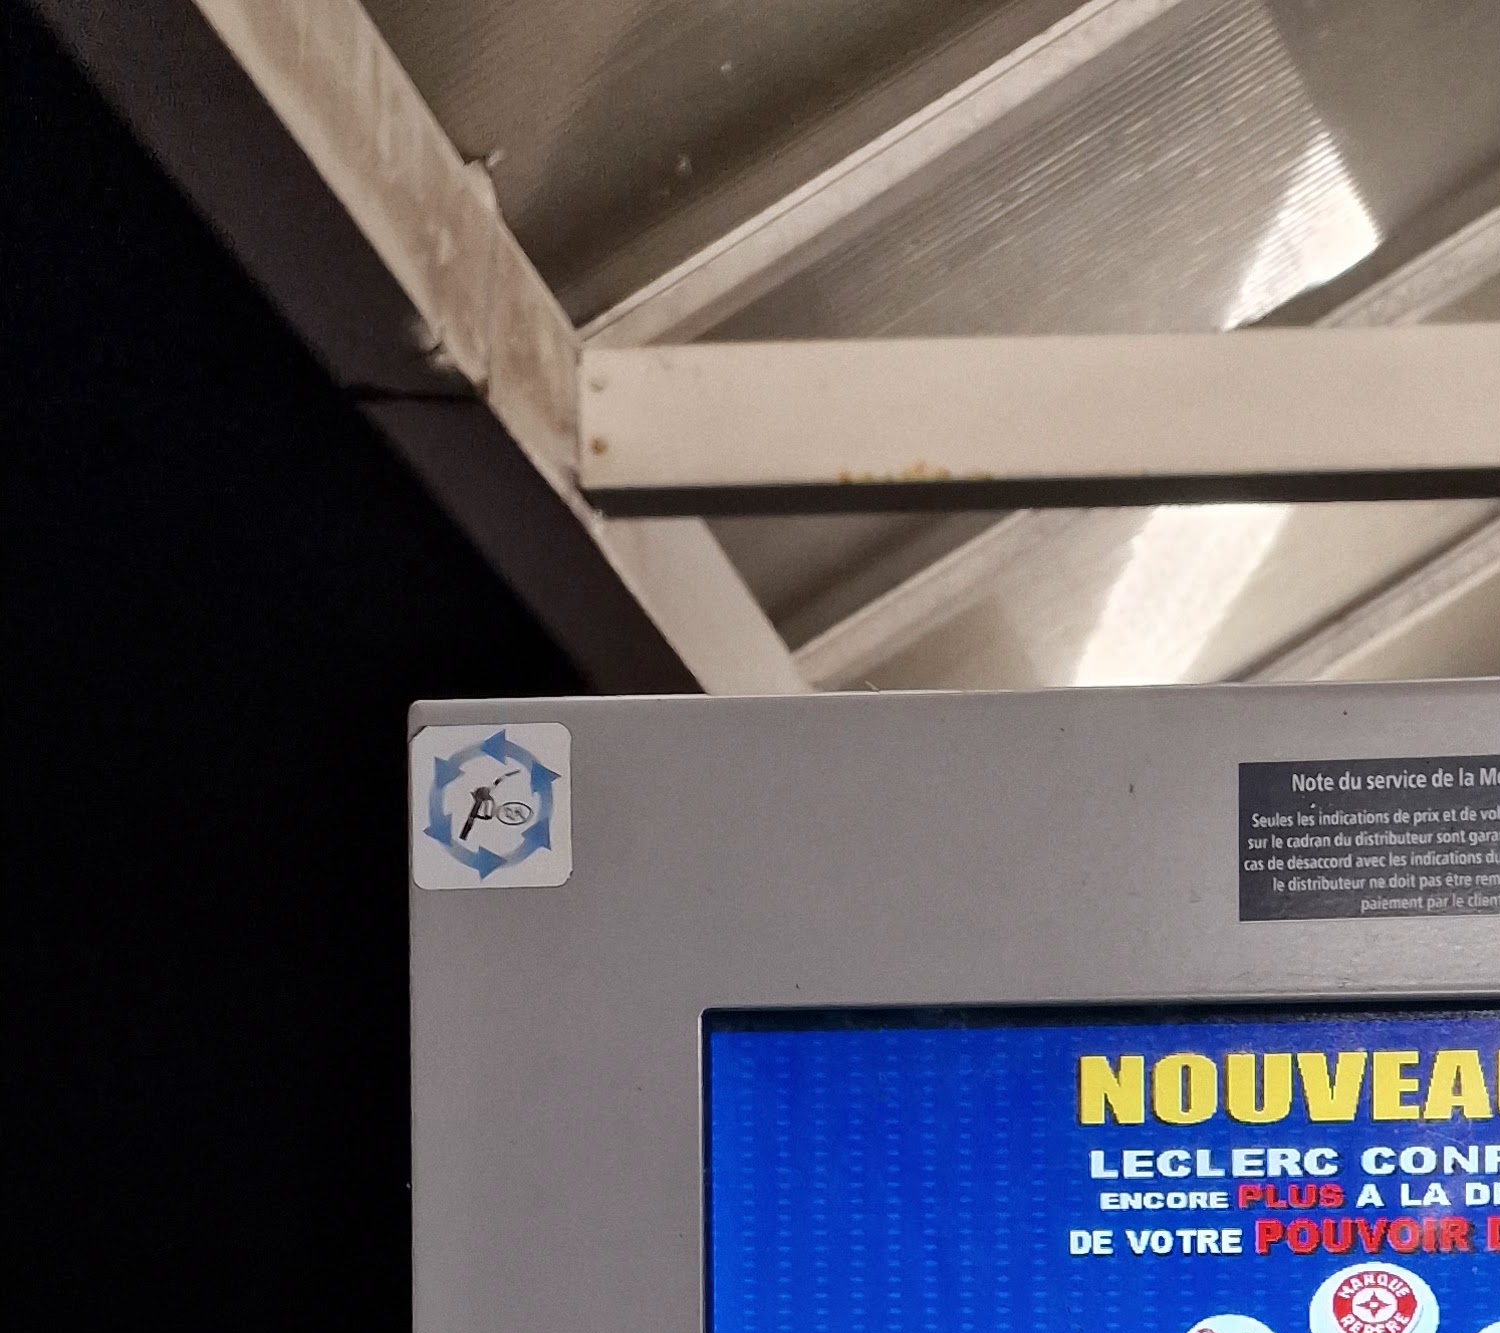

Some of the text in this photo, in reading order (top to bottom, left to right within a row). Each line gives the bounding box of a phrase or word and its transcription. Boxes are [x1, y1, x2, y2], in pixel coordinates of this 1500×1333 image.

[1292, 772, 1334, 792] Note
[1339, 771, 1361, 791] du
[1367, 770, 1427, 790] service
[1432, 767, 1454, 787] de
[1459, 767, 1475, 786] la
[1252, 812, 1293, 827] Seules
[1297, 811, 1315, 826] les
[1318, 809, 1389, 825] indications
[1394, 808, 1409, 823] de
[1413, 806, 1439, 826] prix
[1443, 808, 1456, 821] et
[1460, 806, 1476, 821] de
[1247, 837, 1267, 850] sur
[1271, 834, 1283, 848] le
[1287, 833, 1330, 848] cadran
[1334, 832, 1351, 847] du
[1355, 830, 1432, 846] distributeur
[1436, 830, 1466, 844] sont
[1244, 859, 1264, 871] cas
[1268, 856, 1284, 870] de
[1287, 854, 1352, 869] désaccord
[1356, 856, 1386, 868] avec
[1389, 852, 1407, 867] les
[1411, 850, 1482, 866] indications
[1273, 877, 1285, 892] le
[1288, 875, 1366, 891] distributeur
[1369, 876, 1385, 889] ne
[1389, 874, 1415, 888] doit
[1419, 874, 1442, 891] pas
[1445, 873, 1471, 887] être
[1361, 893, 1464, 913] paiement par le
[1089, 1148, 1338, 1179] LECLERC
[1100, 1191, 1228, 1210] ENCORE
[1238, 1184, 1345, 1209] PLUS
[1356, 1184, 1384, 1208] A
[1400, 1183, 1451, 1207] LA
[1069, 1230, 1114, 1255] DE
[1125, 1229, 1243, 1254] VOTRE
[1255, 1217, 1468, 1256] POUVOIR
[1338, 1274, 1411, 1299] MARQUE
